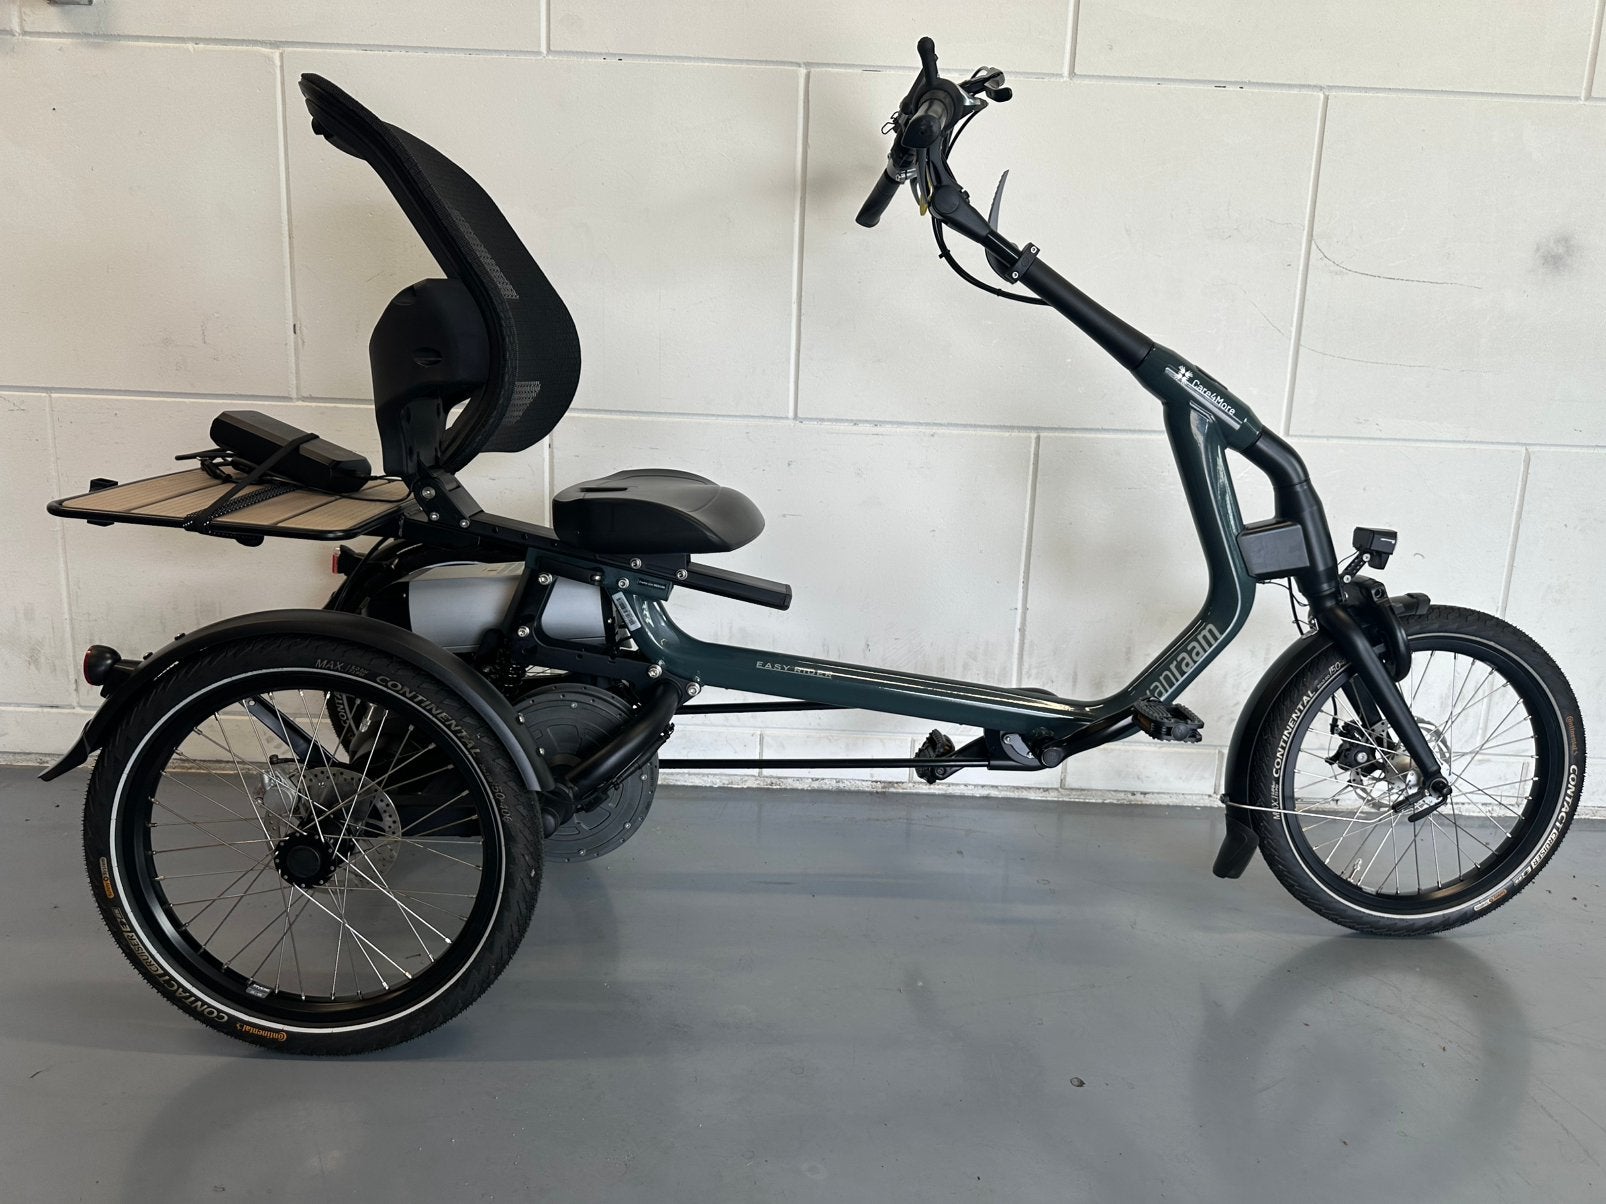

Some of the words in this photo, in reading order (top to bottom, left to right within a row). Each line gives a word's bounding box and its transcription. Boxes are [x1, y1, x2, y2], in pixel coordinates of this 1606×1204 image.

[1191, 379, 1236, 416] Care4More
[756, 660, 790, 671] EASY
[1145, 623, 1222, 699] anraam
[376, 674, 481, 757] CONTINENTAL
[1272, 690, 1316, 778] CONTINENTAL
[1556, 764, 1578, 832] CONTACT
[1532, 832, 1560, 868] CRUISER
[126, 933, 162, 973] CRUISER
[158, 974, 228, 1022] CONTACT
[242, 1024, 288, 1042] Continental
